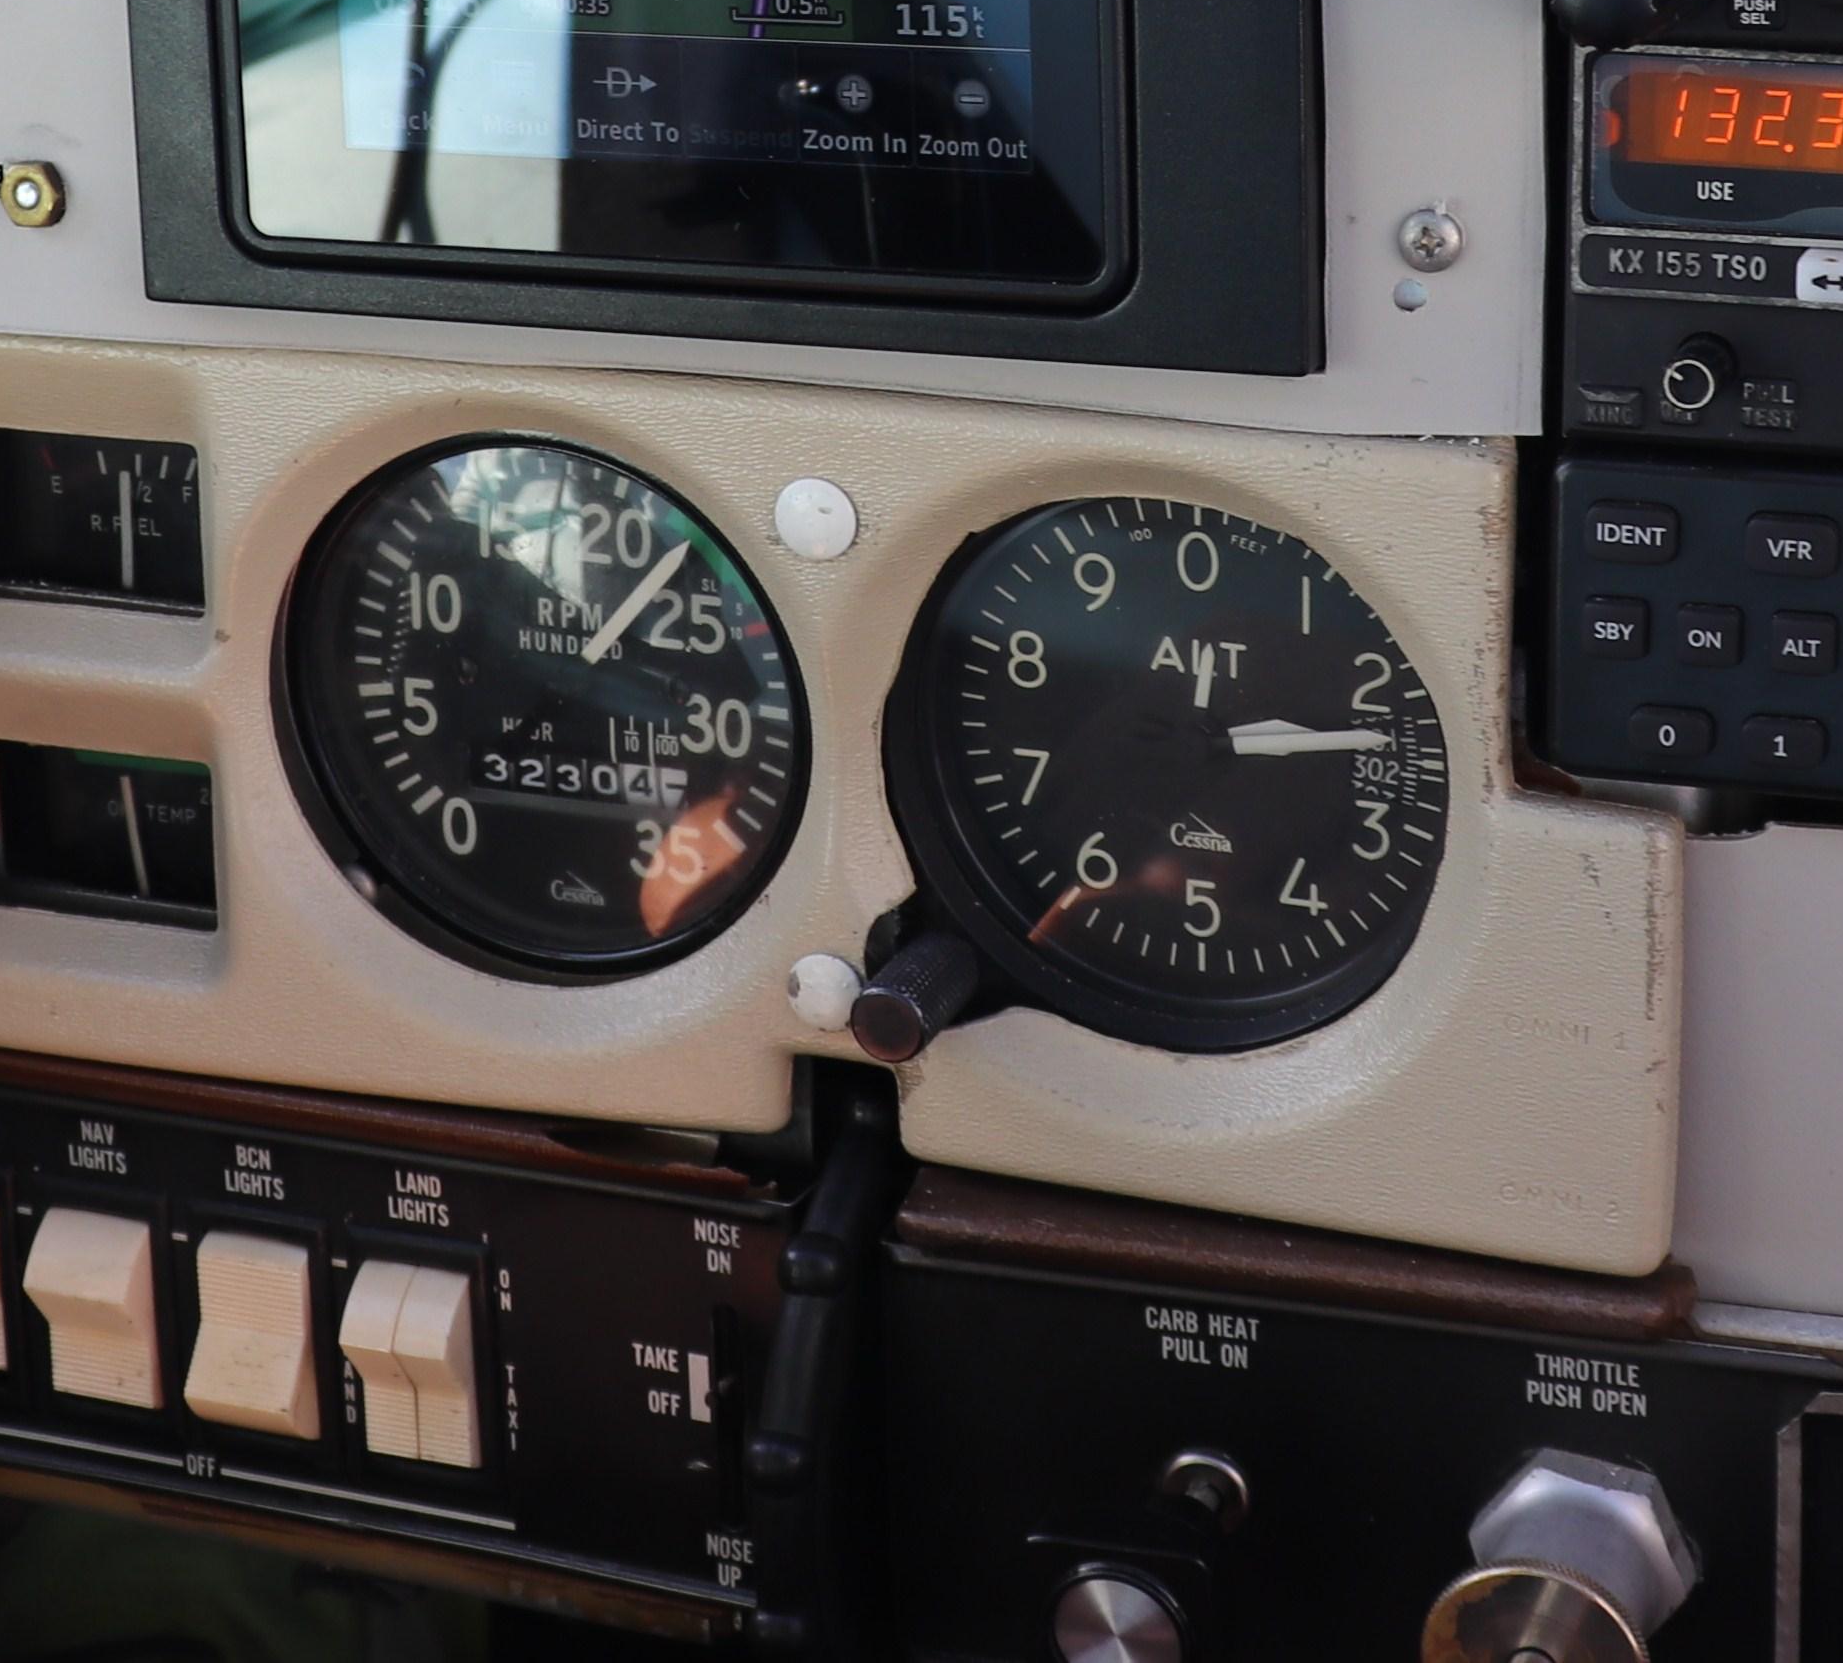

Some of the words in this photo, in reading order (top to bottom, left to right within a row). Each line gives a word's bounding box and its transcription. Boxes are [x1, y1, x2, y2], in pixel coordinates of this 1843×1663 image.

[1740, 12, 1769, 25] SEL
[577, 119, 640, 143] Direct
[649, 122, 679, 145] To
[803, 130, 874, 155] Zoom
[884, 133, 907, 155] In
[918, 135, 981, 158] Zoom
[989, 136, 1027, 160] Out
[1697, 181, 1734, 202] USE
[1608, 249, 1643, 273] KX
[1657, 251, 1701, 276] 155
[1715, 254, 1766, 281] TSO
[1596, 522, 1665, 547] IDENT
[1766, 538, 1812, 561] VFR
[537, 598, 603, 629] RPM
[1593, 620, 1633, 642] SBY
[1688, 629, 1722, 649] ON
[1782, 637, 1820, 659] ALT
[1170, 824, 1232, 854] Cessna
[80, 1119, 114, 1144] NAV
[68, 1144, 127, 1175] LIGHTS
[236, 1144, 272, 1171] BCN
[224, 1168, 284, 1201] LIGHTS
[395, 1170, 442, 1198] LAND
[388, 1193, 450, 1227] LIGHTS
[1145, 1306, 1199, 1335] CARB
[1208, 1311, 1258, 1341] HEAT
[632, 1343, 679, 1373] TAKE
[1162, 1335, 1211, 1364] PULL
[1220, 1342, 1248, 1368] ON
[1536, 1353, 1639, 1388] THROTTLE
[648, 1390, 680, 1416] OFF
[1526, 1380, 1582, 1411] PUSH
[1592, 1387, 1647, 1417] OPEN
[187, 1452, 216, 1478] OFF
